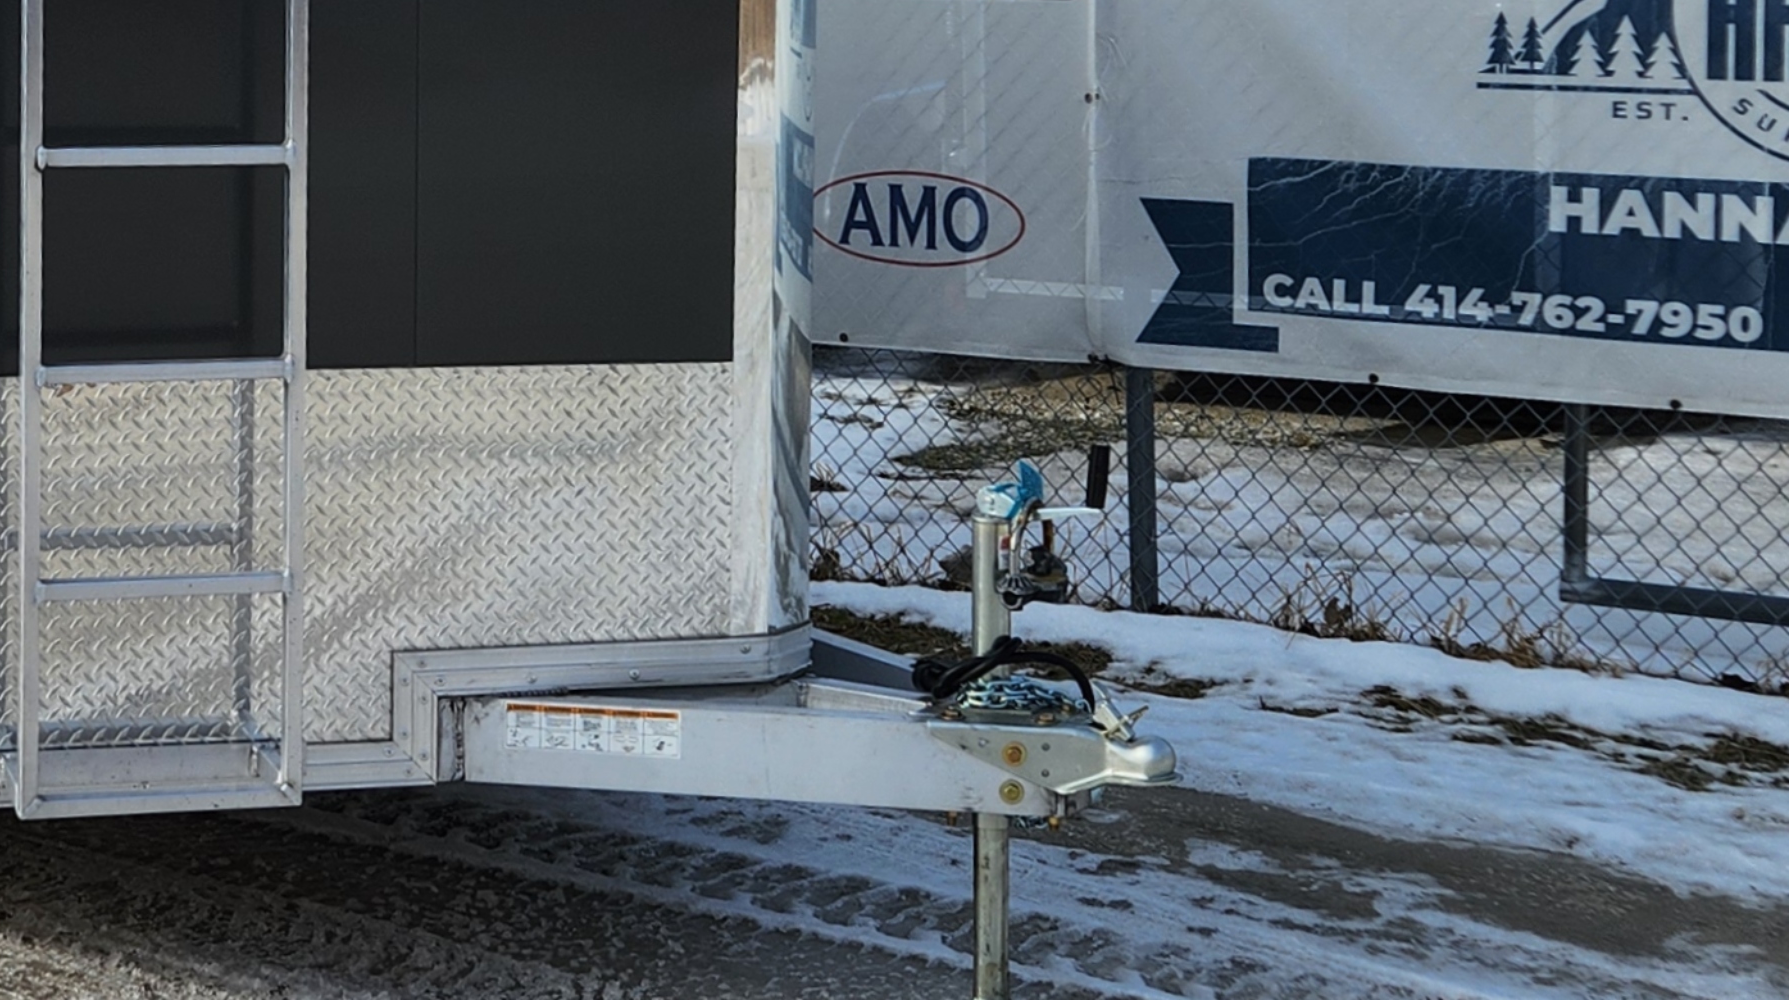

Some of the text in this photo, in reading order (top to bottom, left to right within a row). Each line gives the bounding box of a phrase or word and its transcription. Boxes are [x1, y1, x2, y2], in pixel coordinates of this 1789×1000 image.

[1611, 100, 1689, 122] EST.
[1731, 97, 1789, 143] SU
[838, 181, 990, 254] AMO
[1547, 184, 1789, 246] HANN
[1261, 272, 1765, 344] CALL 414-762-7950
